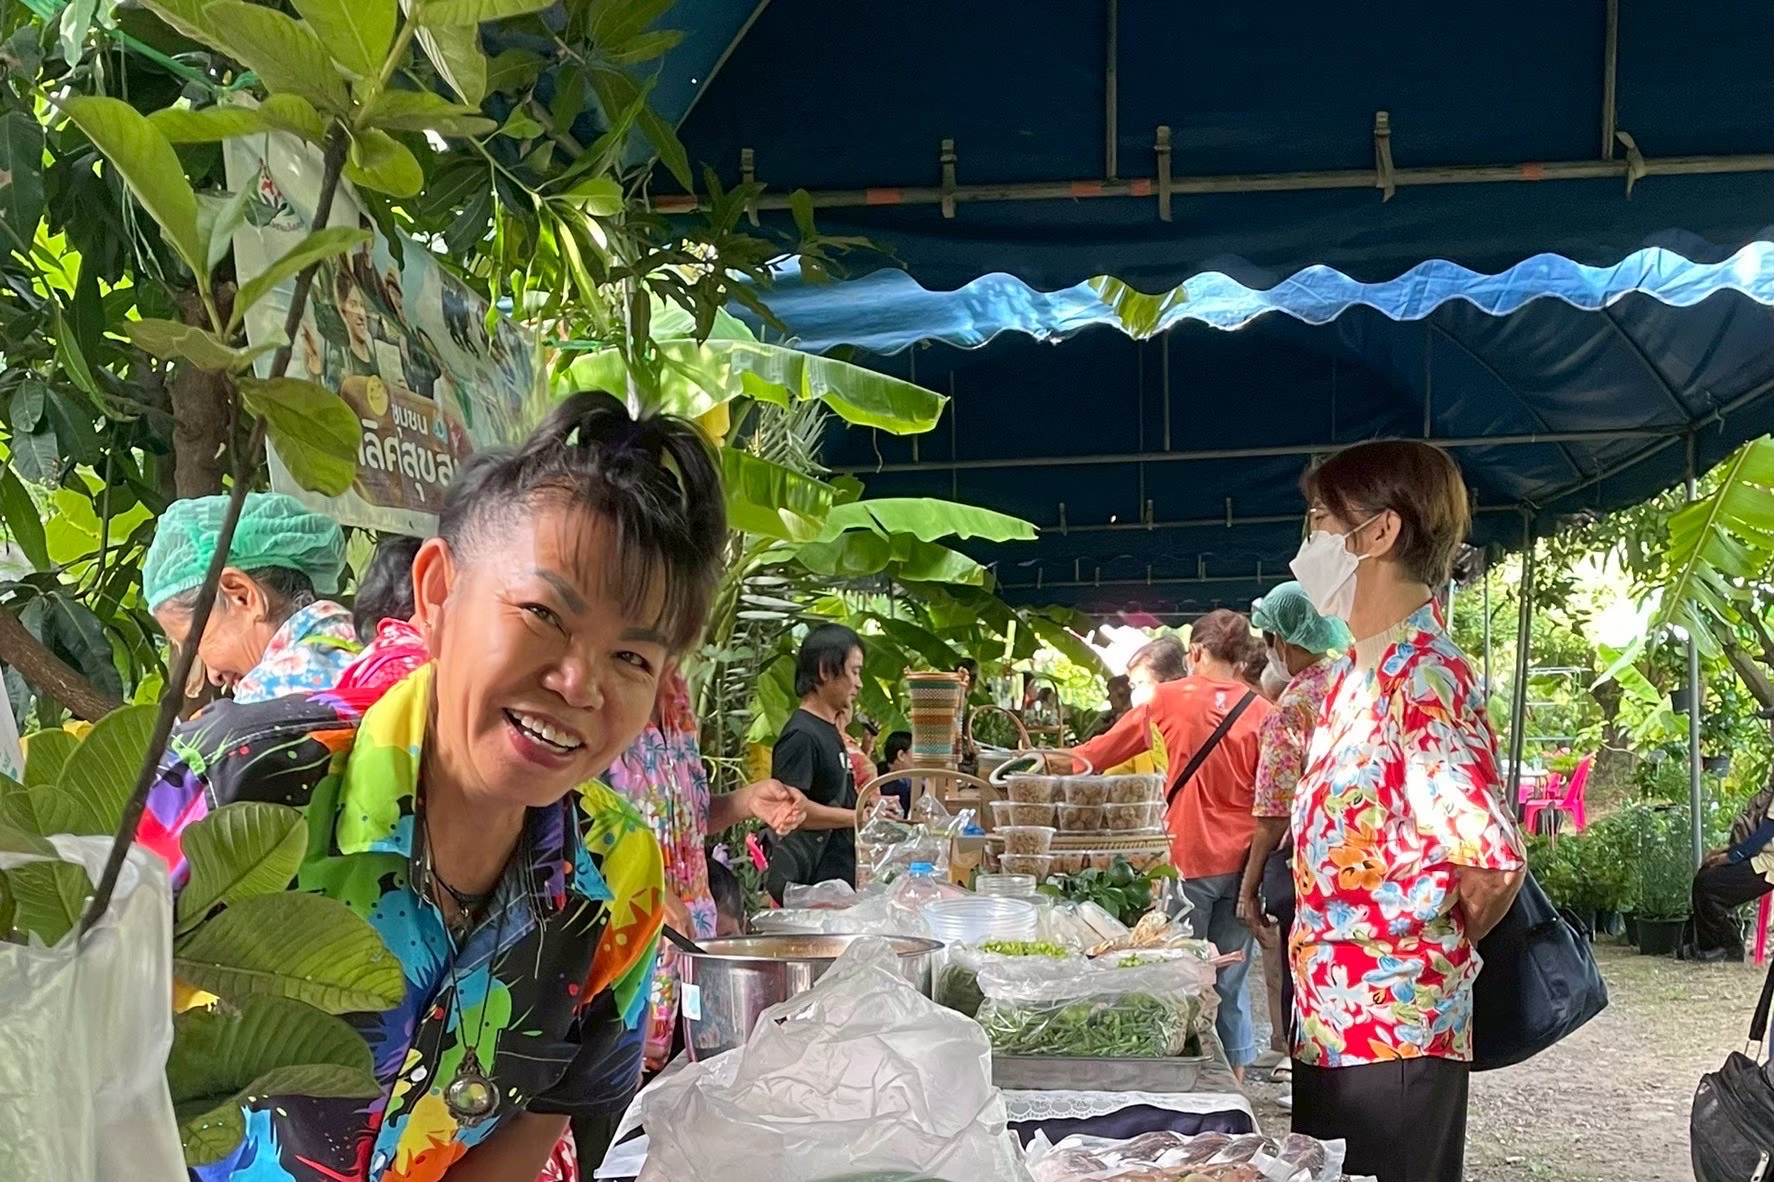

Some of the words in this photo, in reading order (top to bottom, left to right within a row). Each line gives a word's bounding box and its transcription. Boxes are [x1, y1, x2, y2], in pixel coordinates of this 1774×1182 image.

[391, 403, 428, 438] ชุมชน
[359, 419, 459, 502] เลิศสุขส
